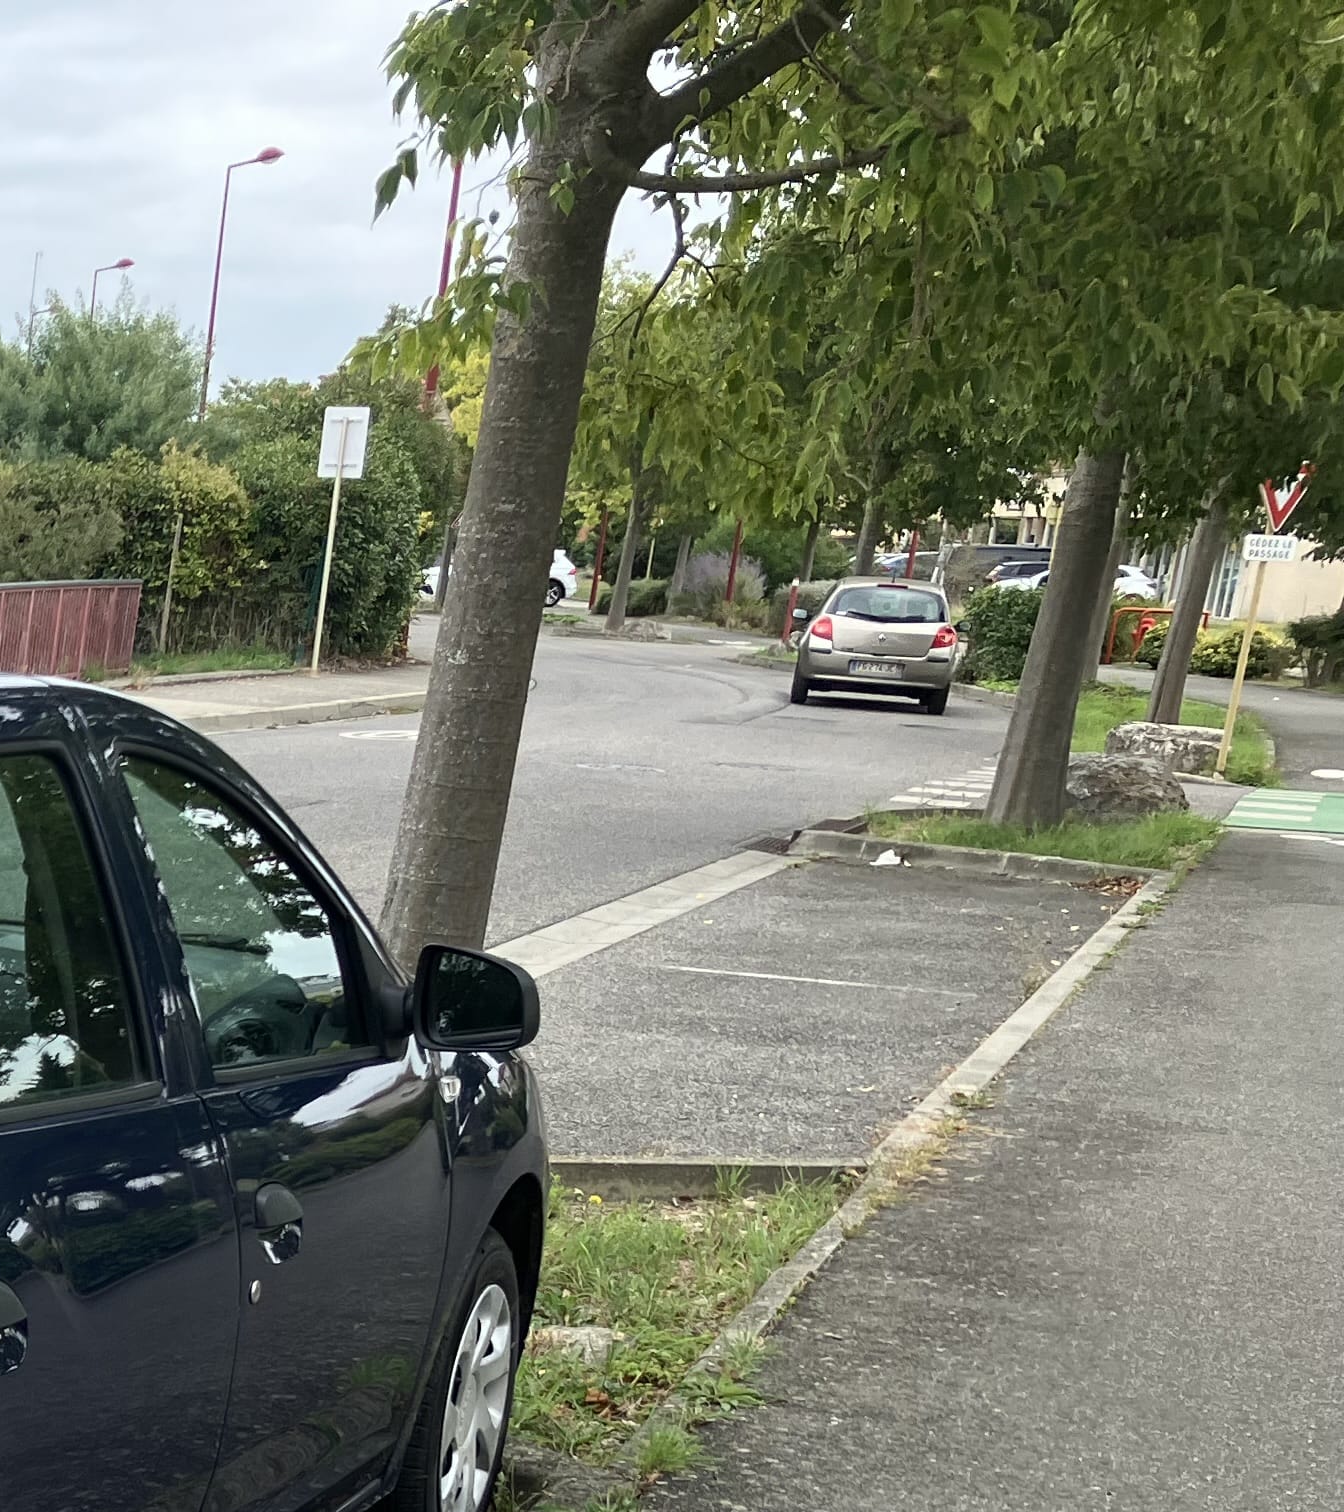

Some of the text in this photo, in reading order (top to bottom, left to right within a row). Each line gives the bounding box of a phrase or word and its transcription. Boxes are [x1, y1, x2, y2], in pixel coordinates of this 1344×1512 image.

[1250, 538, 1292, 549] CÉDEZ LE
[1248, 549, 1290, 559] PASSAGE
